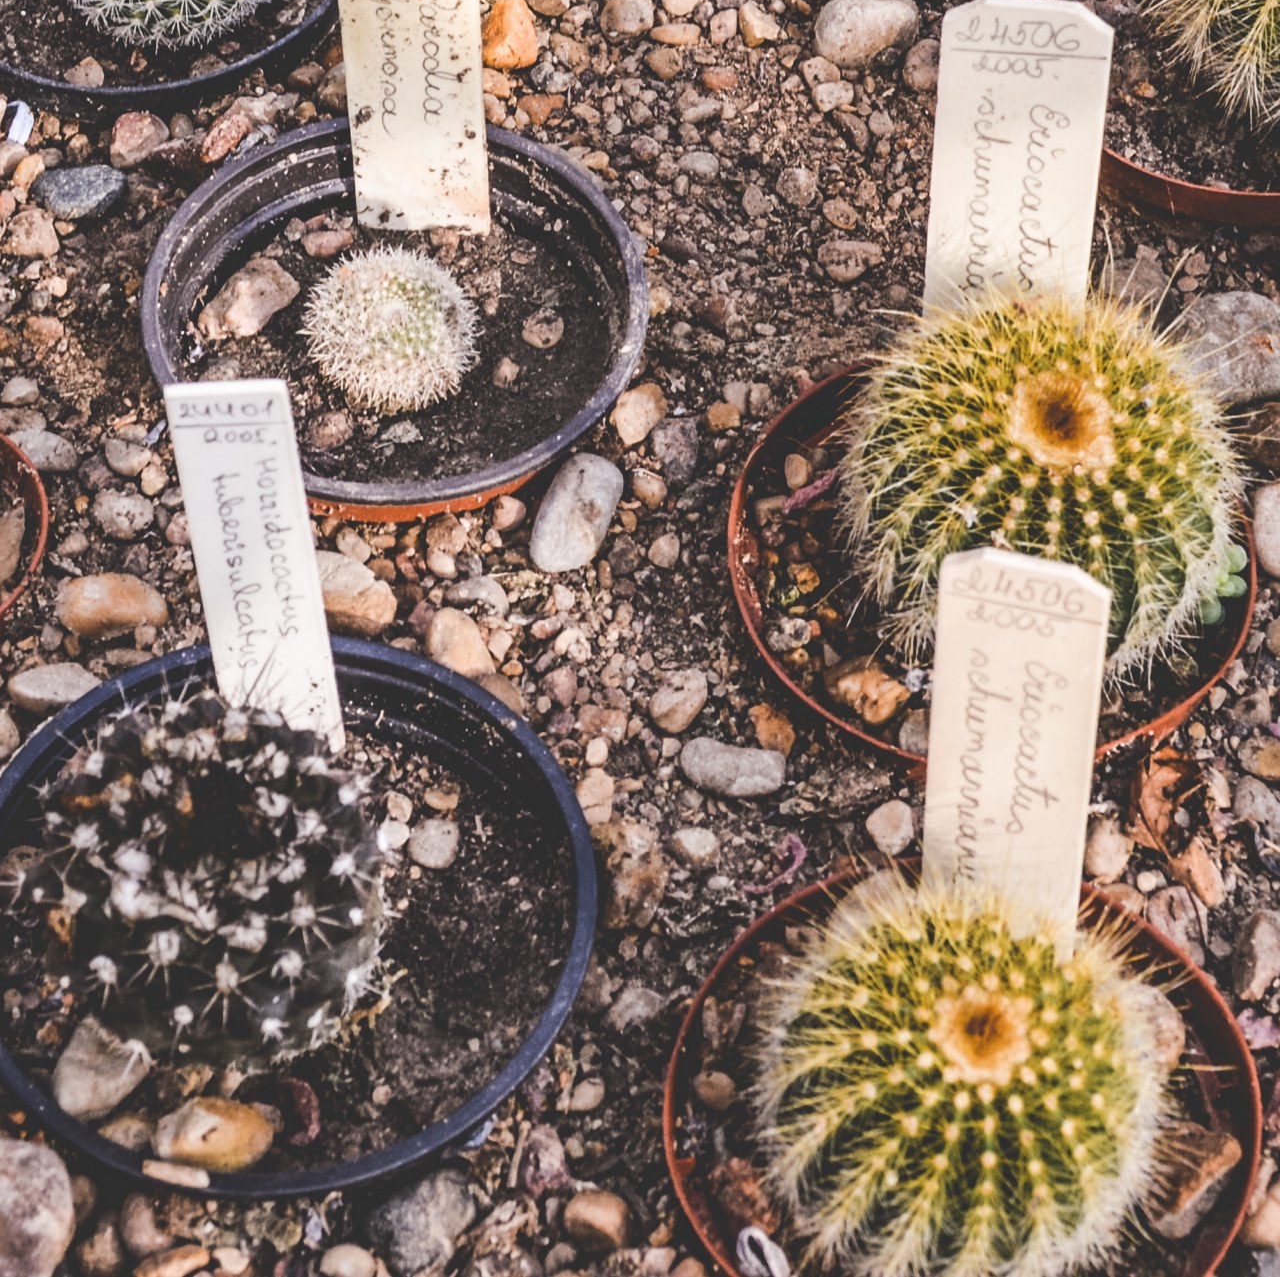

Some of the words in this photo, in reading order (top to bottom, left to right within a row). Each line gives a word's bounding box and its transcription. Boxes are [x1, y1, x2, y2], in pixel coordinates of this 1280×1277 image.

[955, 15, 1082, 53] 24506
[179, 399, 273, 420] 24401
[253, 457, 303, 637] Horridocactus
[951, 567, 1088, 617] 24506
